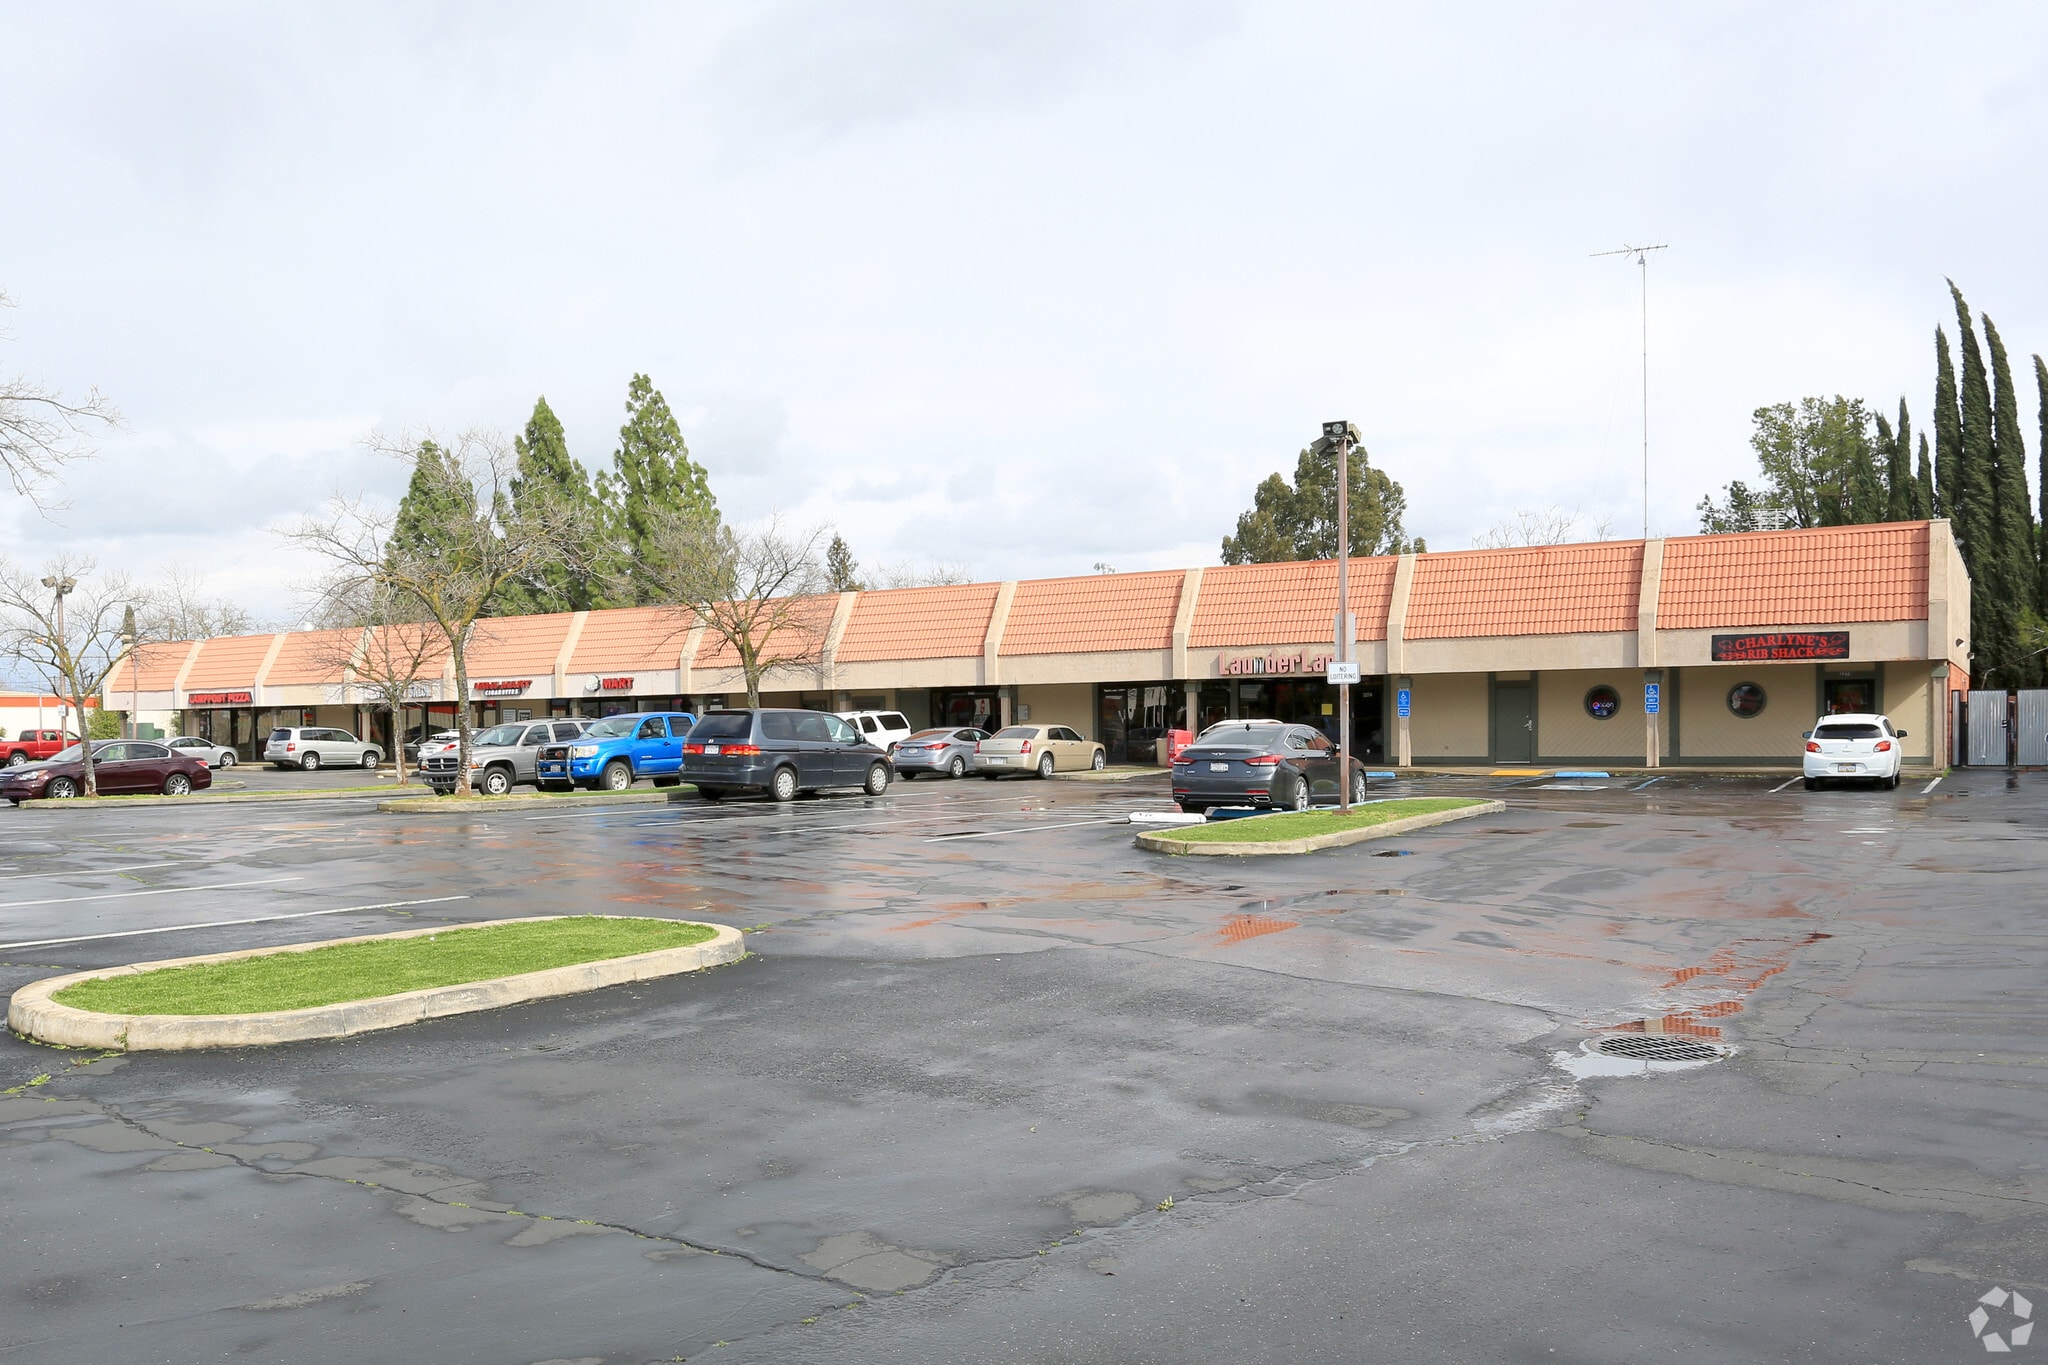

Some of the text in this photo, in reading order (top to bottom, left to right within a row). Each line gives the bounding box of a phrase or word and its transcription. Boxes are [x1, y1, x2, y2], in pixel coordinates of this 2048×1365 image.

[1735, 634, 1828, 650] CHARLYNE'S
[1747, 647, 1815, 659] RIB SHACK
[1218, 649, 1336, 675] LaunderLan
[602, 677, 633, 689] MART
[227, 692, 251, 702] PIZZA
